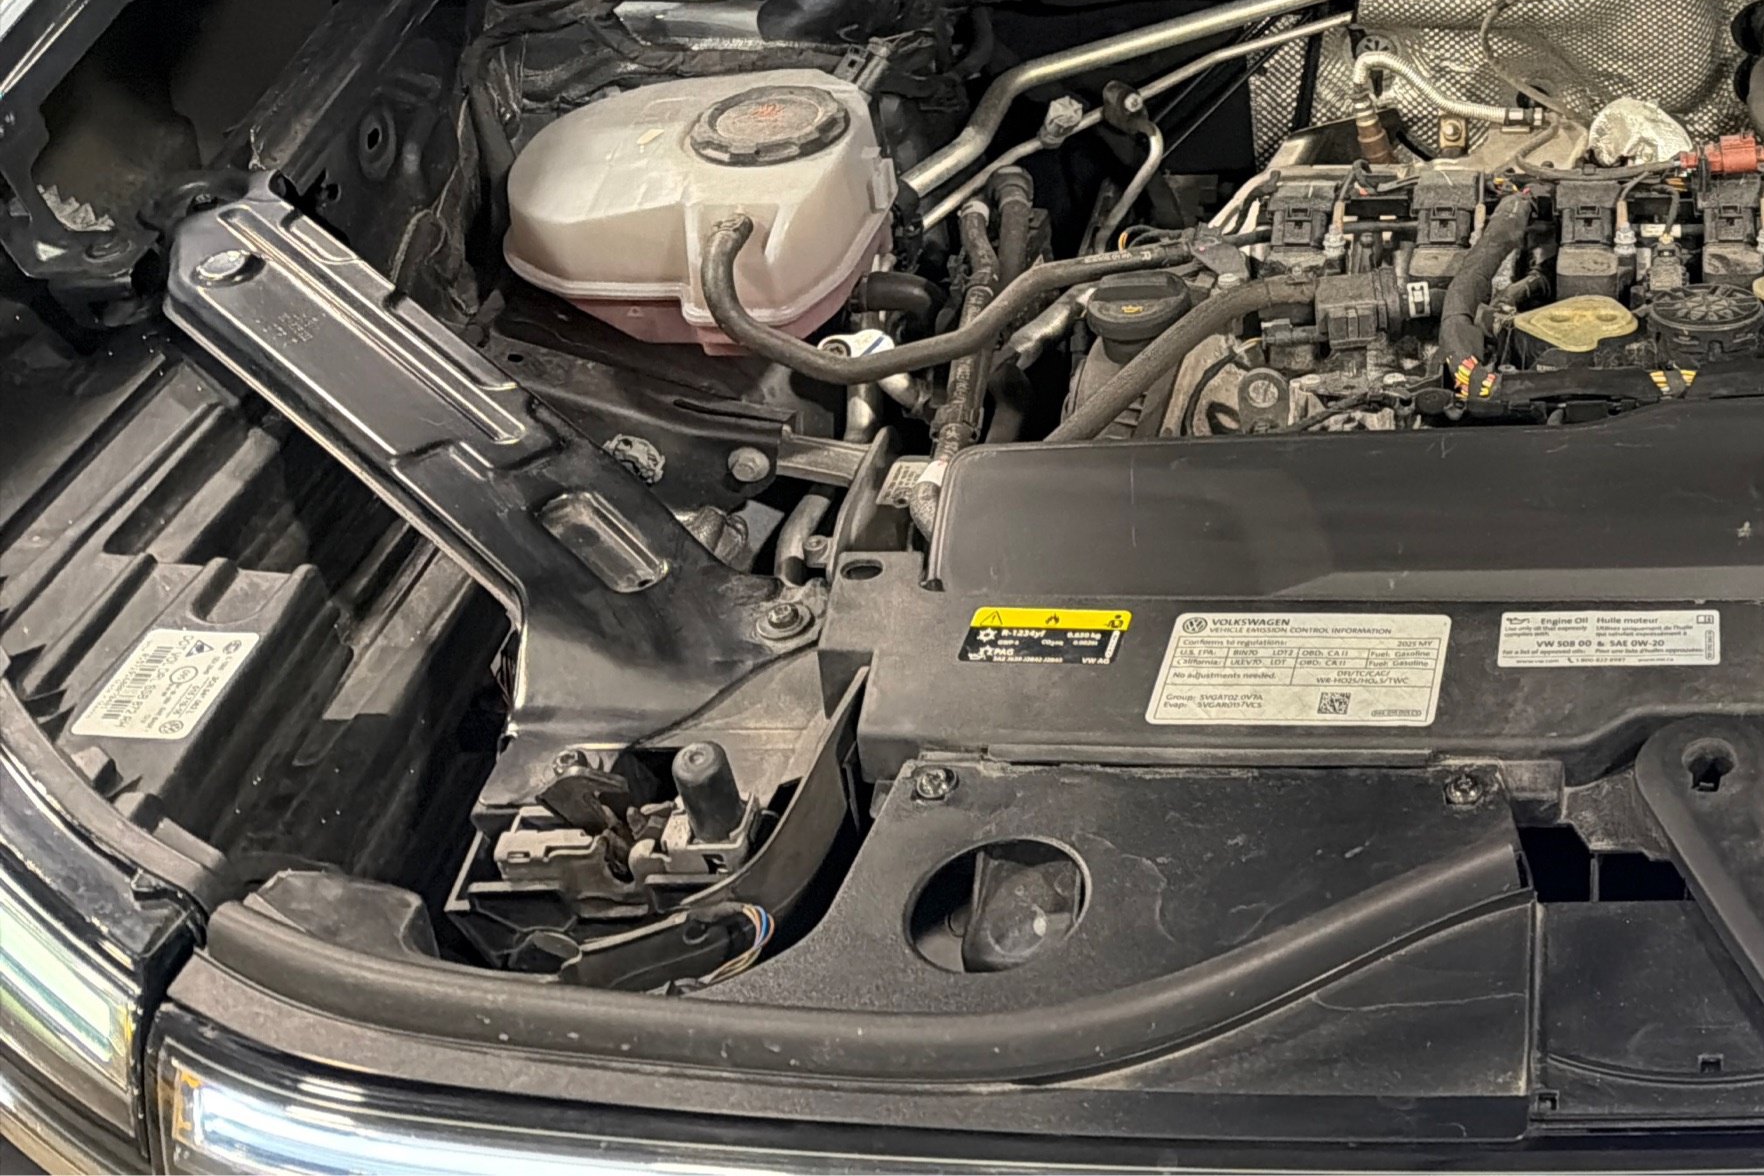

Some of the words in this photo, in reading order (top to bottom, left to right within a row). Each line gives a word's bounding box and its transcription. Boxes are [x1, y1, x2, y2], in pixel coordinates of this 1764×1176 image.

[1540, 617, 1572, 625] Engine
[1536, 640, 1555, 648] VW
[1557, 640, 1575, 648] 508
[1578, 640, 1592, 648] 00
